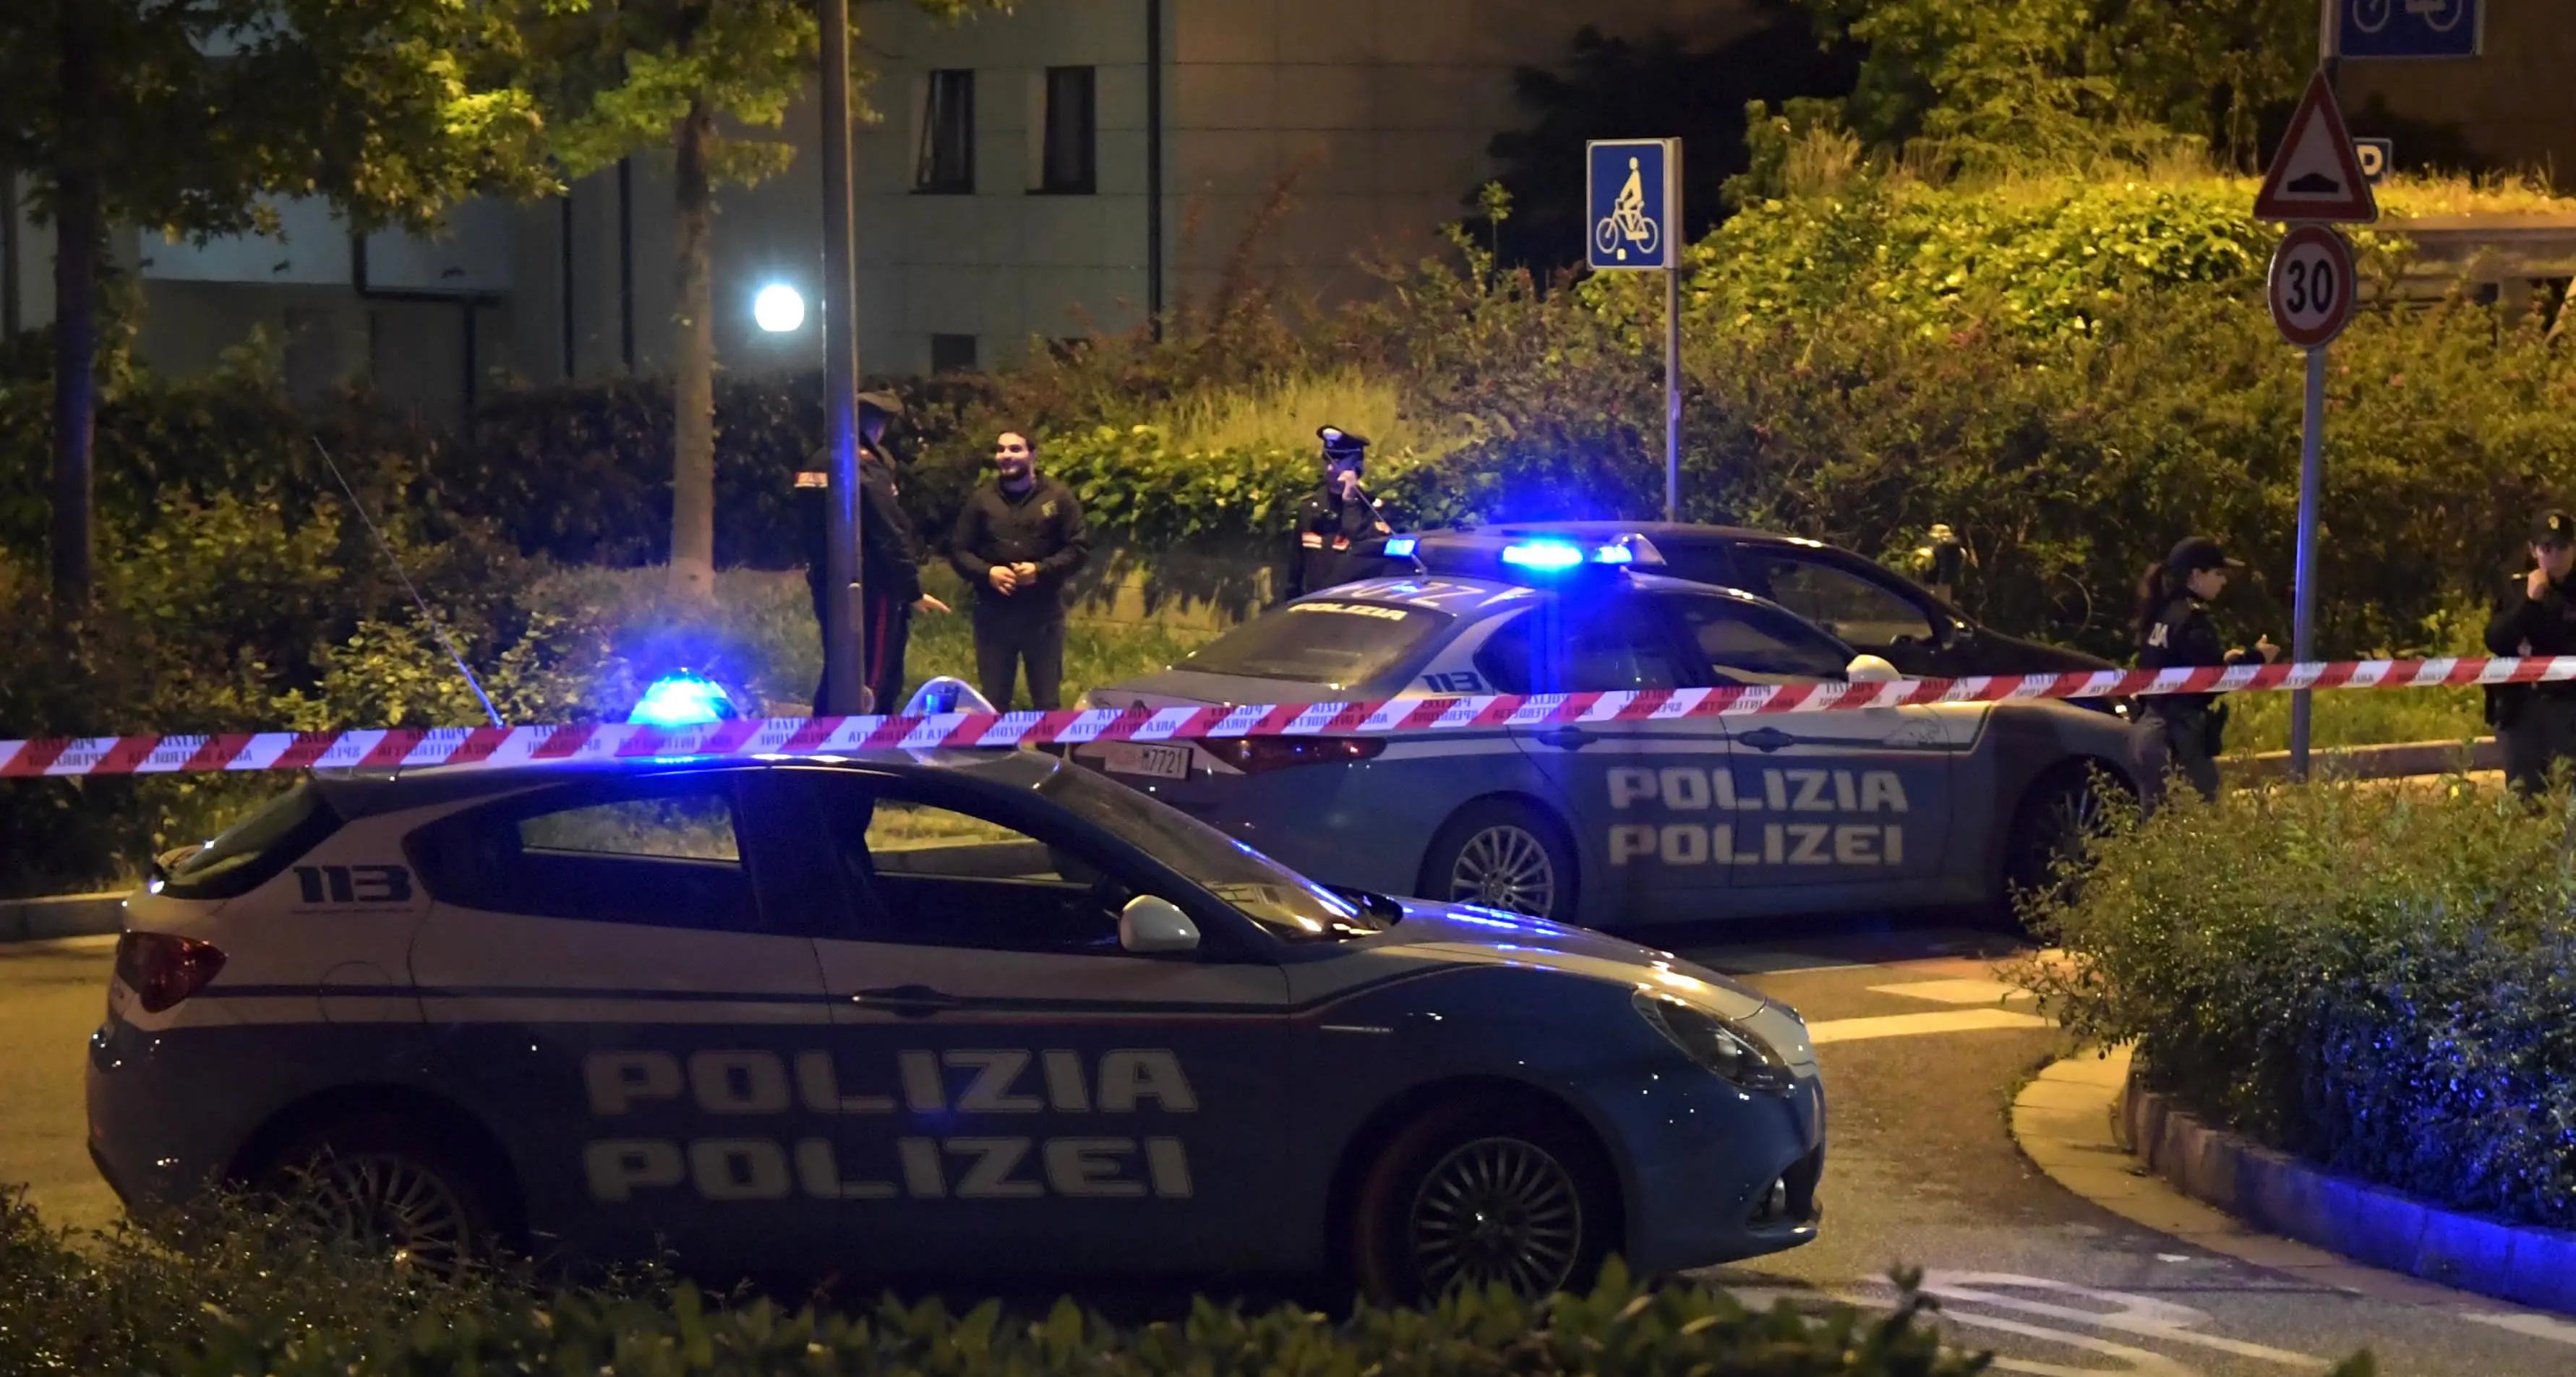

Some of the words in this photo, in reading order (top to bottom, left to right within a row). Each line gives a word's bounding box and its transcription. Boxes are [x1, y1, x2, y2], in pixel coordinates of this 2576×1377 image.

[2287, 259, 2333, 314] 30
[1287, 602, 1409, 622] POLIZIA
[1421, 671, 1484, 694] 113
[1605, 766, 1909, 813] POLIZIA
[1607, 824, 1904, 866] POLIZEI
[292, 865, 414, 904] 113
[581, 1049, 1200, 1114] POLIZIA
[583, 1136, 1194, 1201] POLIZEI
